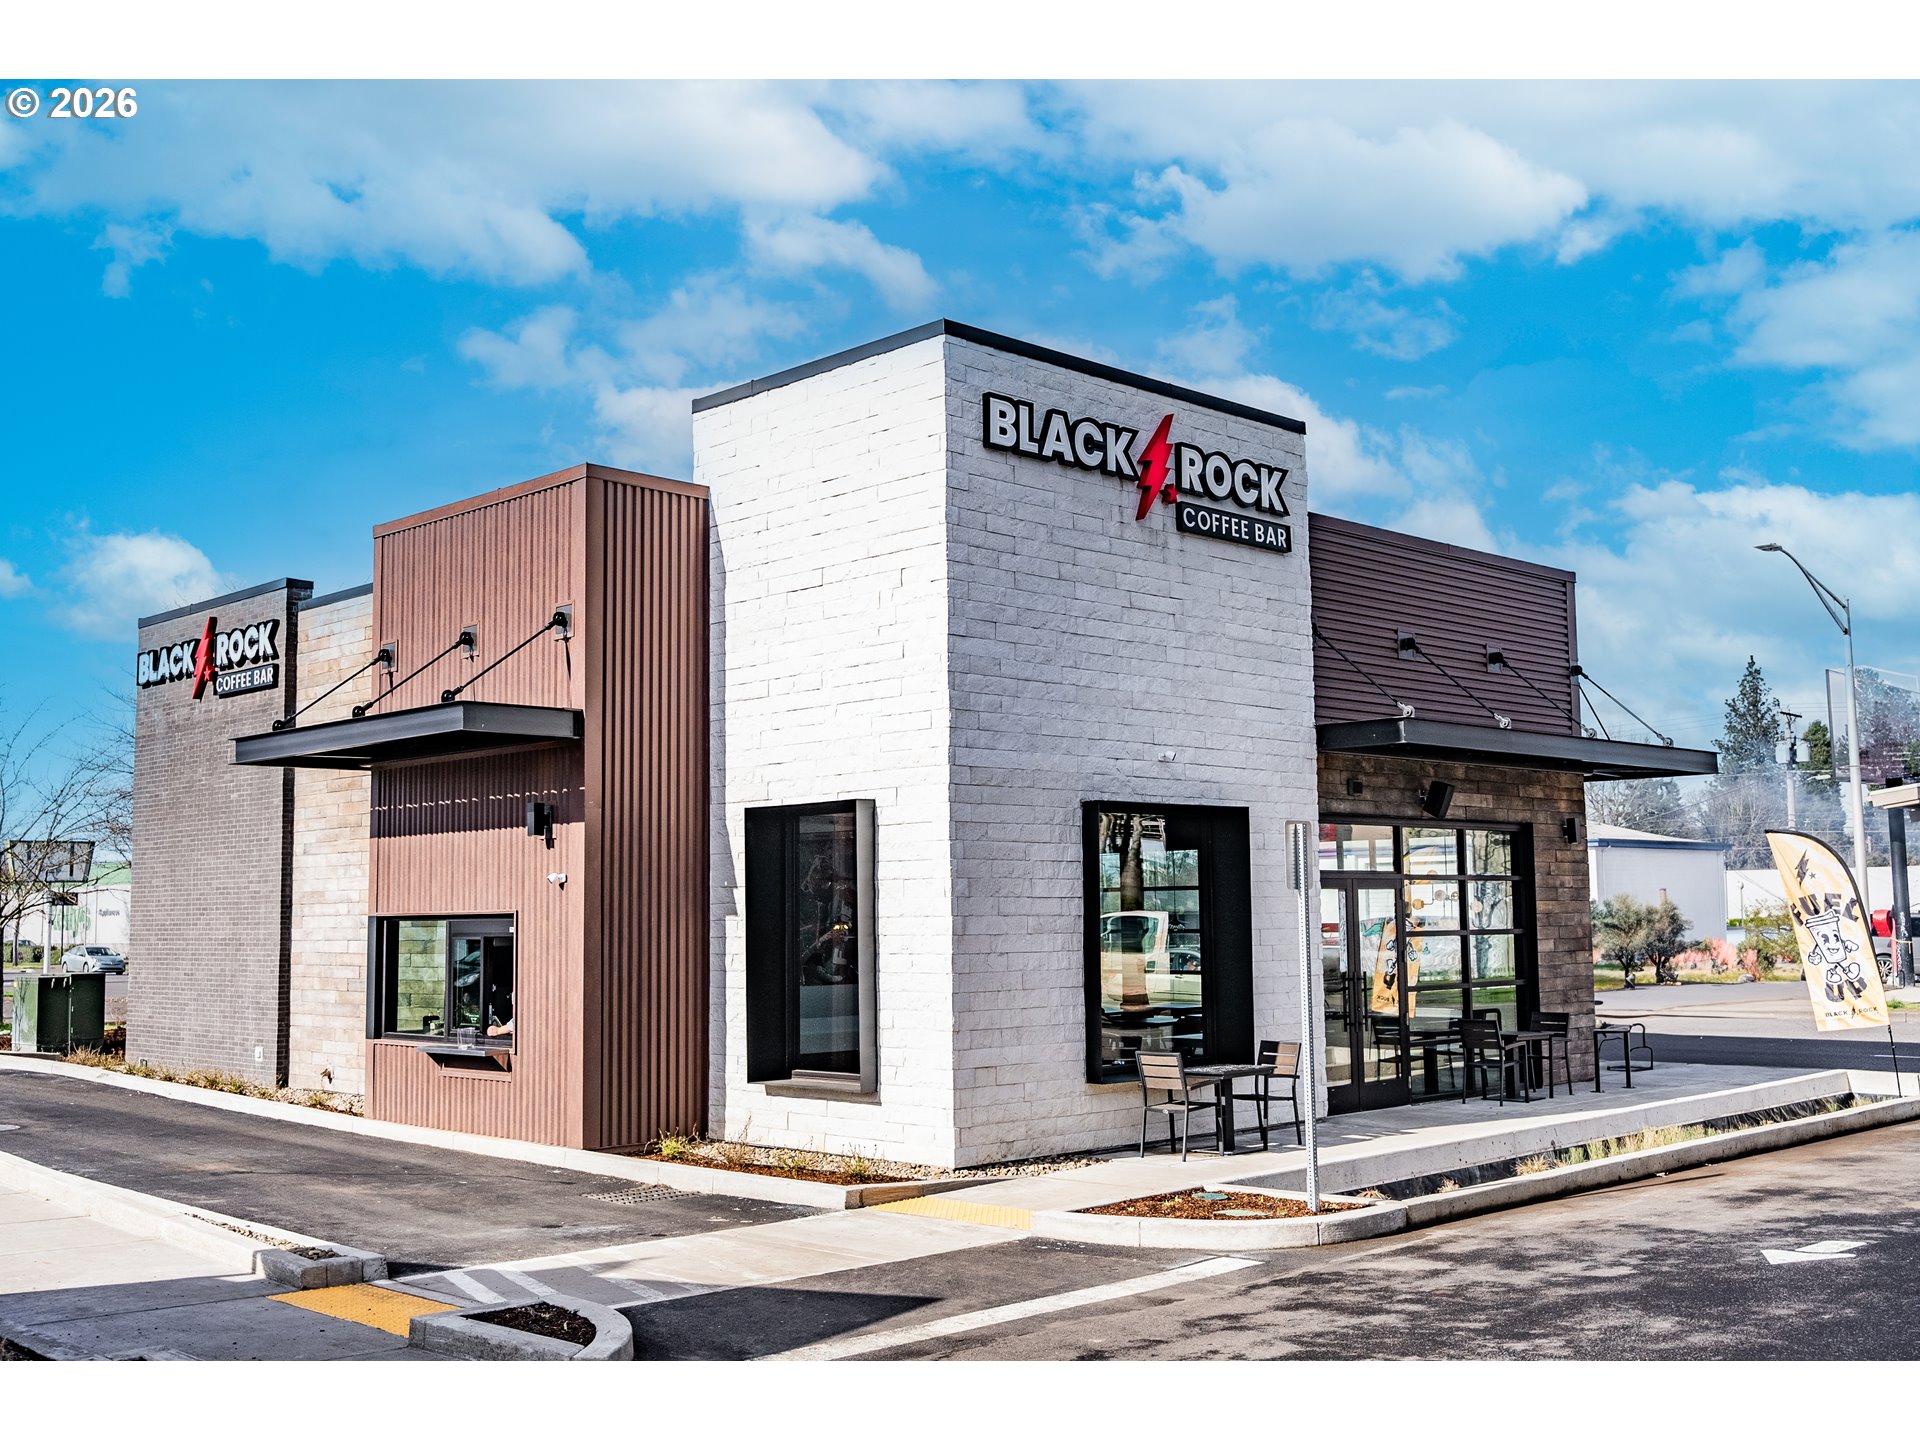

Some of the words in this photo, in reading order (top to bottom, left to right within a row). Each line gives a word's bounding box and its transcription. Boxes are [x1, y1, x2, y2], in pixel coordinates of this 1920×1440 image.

[987, 395, 1137, 478] BLACK
[1180, 444, 1285, 515] ROCK
[1182, 507, 1250, 541] COFFEE
[1255, 522, 1288, 550] BAR
[138, 640, 196, 685] BLACK
[215, 620, 274, 667] ROCK
[215, 672, 252, 693] COFFEE
[253, 667, 274, 686] BAR
[1824, 976, 1868, 1003] UP
[1825, 1009, 1848, 1018] BLACK
[1858, 1006, 1879, 1014] ROCK
